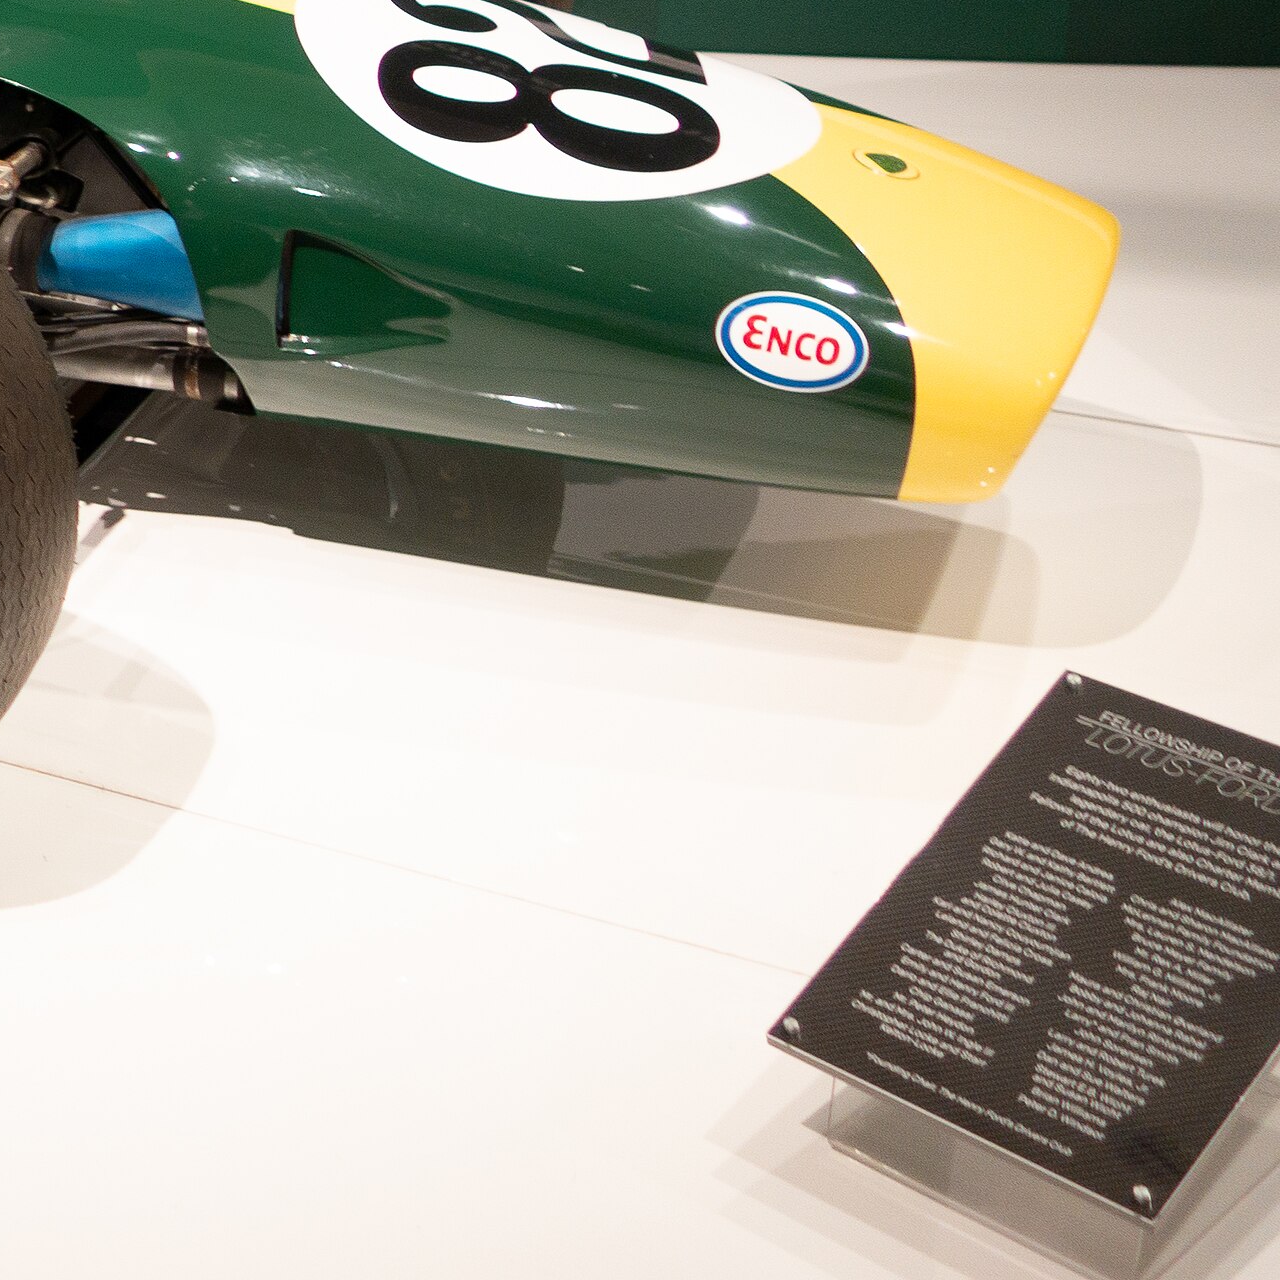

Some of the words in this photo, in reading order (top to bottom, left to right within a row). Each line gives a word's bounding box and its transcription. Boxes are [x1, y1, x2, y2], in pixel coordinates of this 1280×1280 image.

[742, 314, 840, 367] ENCO
[1100, 711, 1222, 760] FELLOWSHIP
[1224, 757, 1254, 772] OF
[1258, 768, 1280, 786] TH
